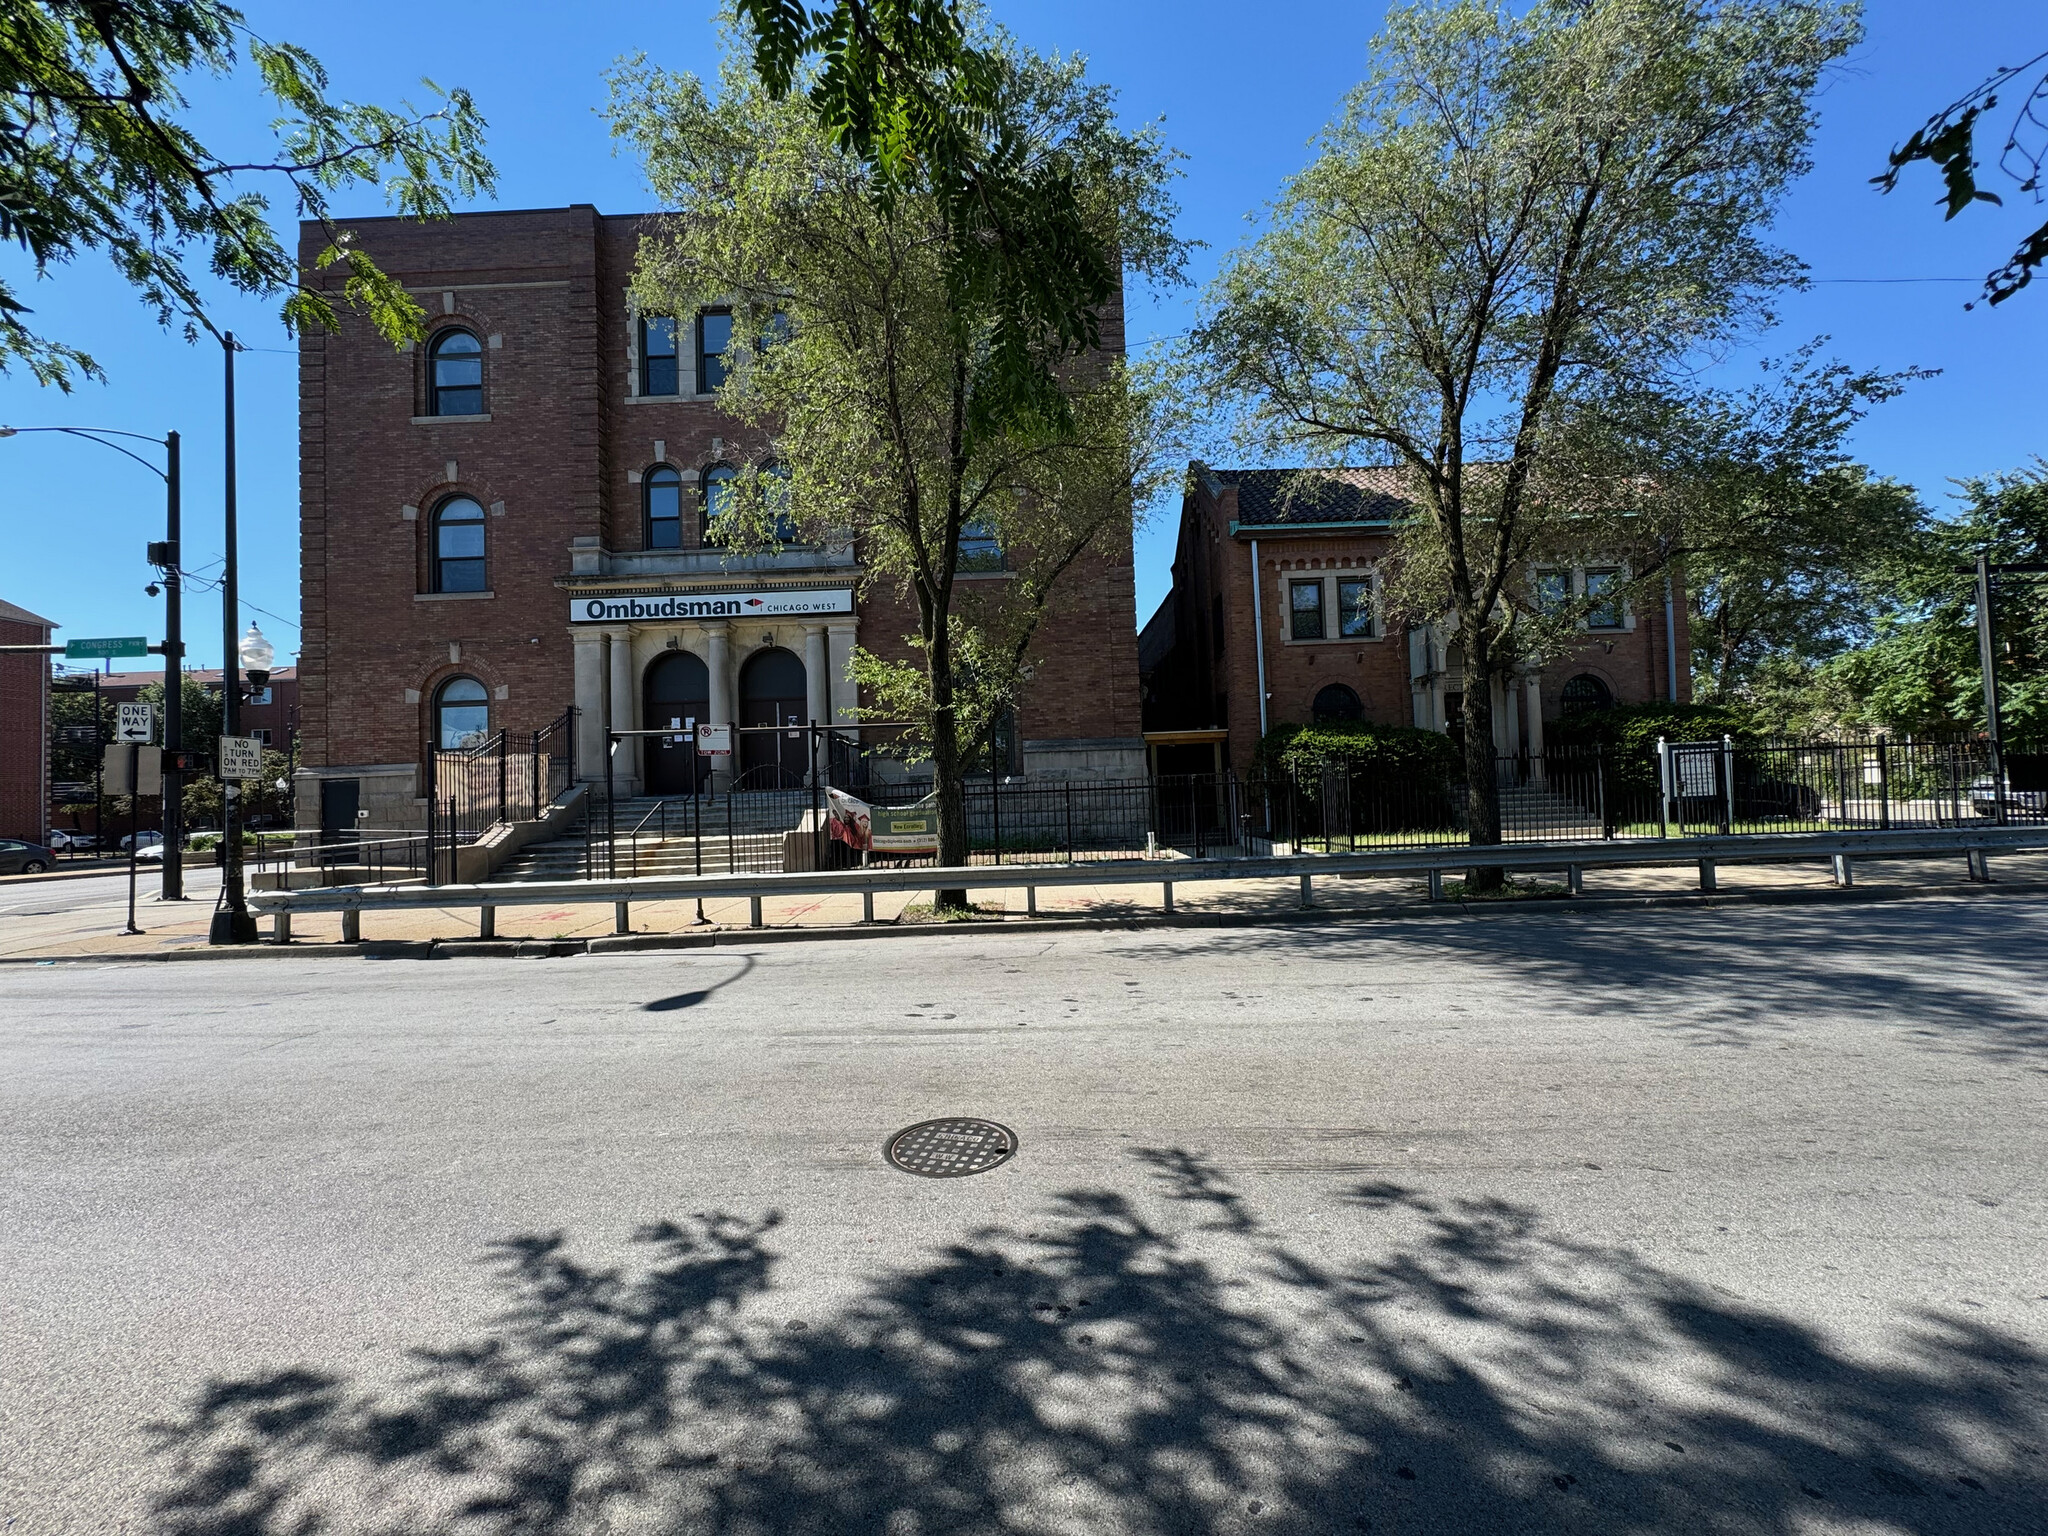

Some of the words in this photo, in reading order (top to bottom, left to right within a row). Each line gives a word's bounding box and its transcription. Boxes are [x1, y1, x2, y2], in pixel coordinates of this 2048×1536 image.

[586, 598, 741, 619] Ombudsman
[767, 603, 809, 613] CHICAGO
[812, 602, 837, 611] WEST
[80, 640, 123, 650] CONGRESS
[122, 706, 148, 716] ONE
[122, 717, 148, 726] WAY
[234, 740, 249, 748] NO
[229, 749, 254, 757] TURN
[223, 758, 236, 766] ON
[242, 759, 259, 767] RED
[938, 1133, 980, 1142] CHICAGO
